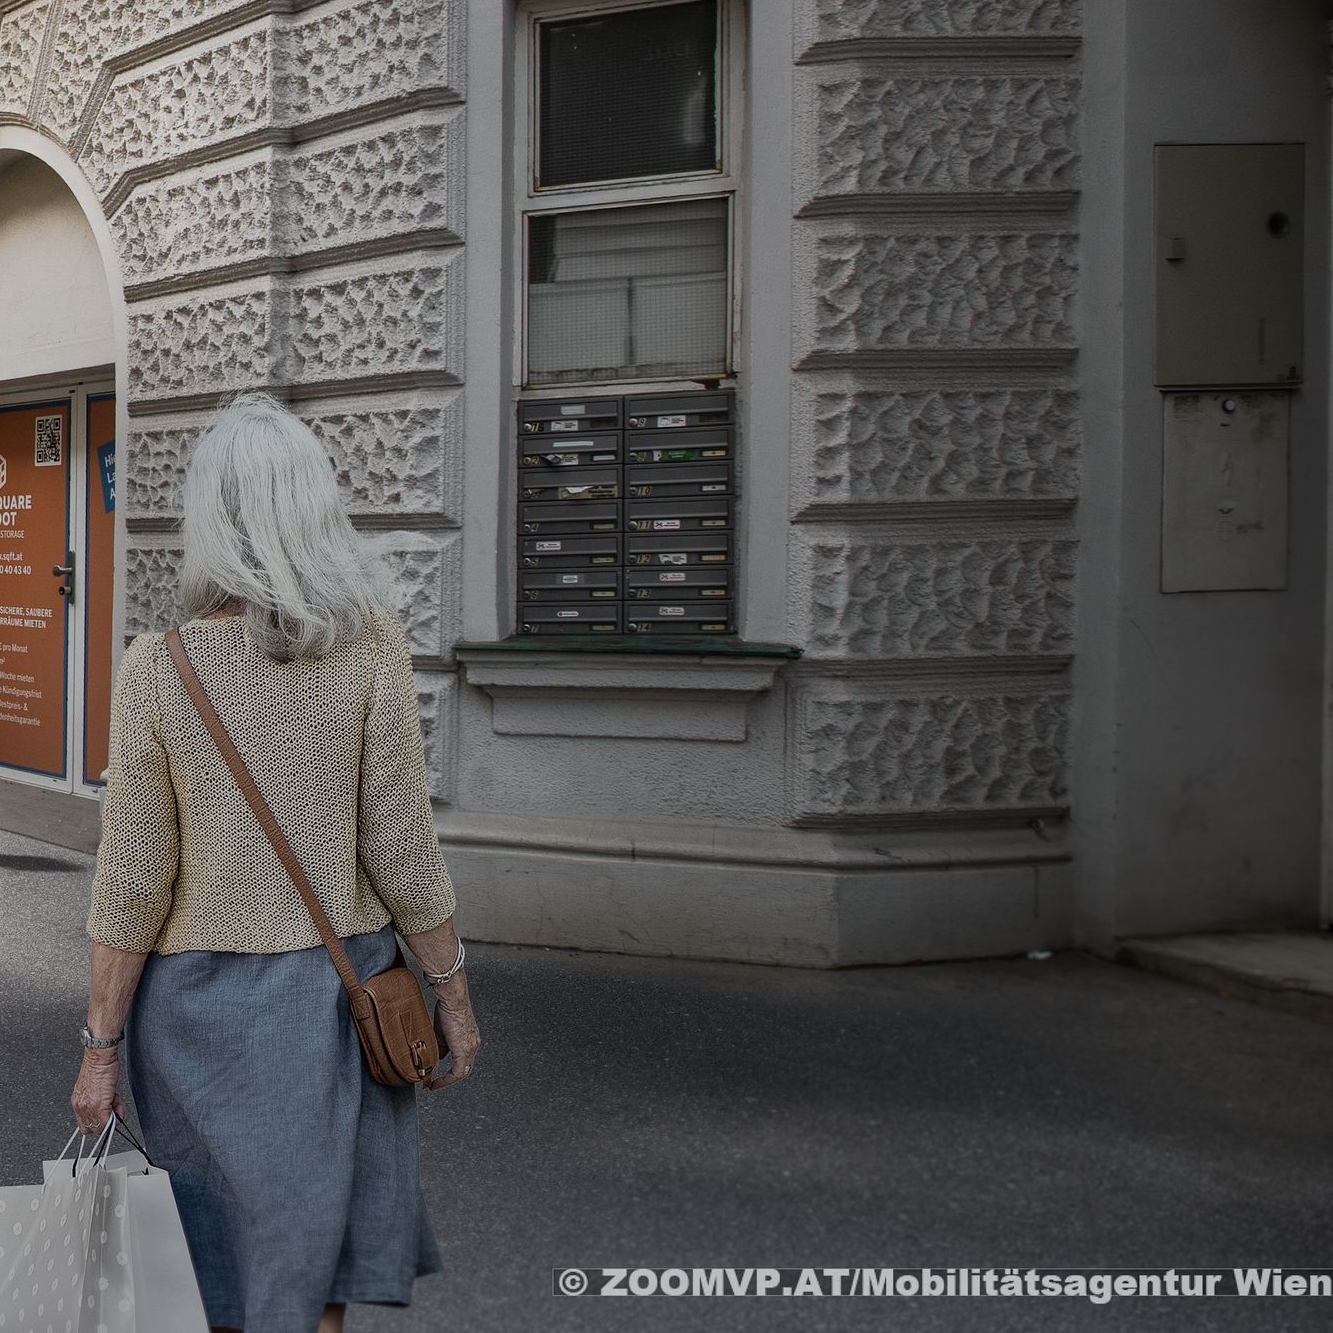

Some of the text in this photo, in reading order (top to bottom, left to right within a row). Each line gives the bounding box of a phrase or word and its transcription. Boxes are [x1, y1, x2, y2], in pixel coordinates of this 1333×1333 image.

[4, 564, 13, 575] 40
[13, 565, 22, 575] 43
[22, 565, 32, 575] 40
[0, 605, 25, 617] SICHERE,
[25, 607, 53, 618] SAUBERE
[24, 619, 46, 629] MIETEN
[11, 643, 28, 653] Monat
[0, 671, 16, 681] Woche
[16, 674, 35, 683] mieten
